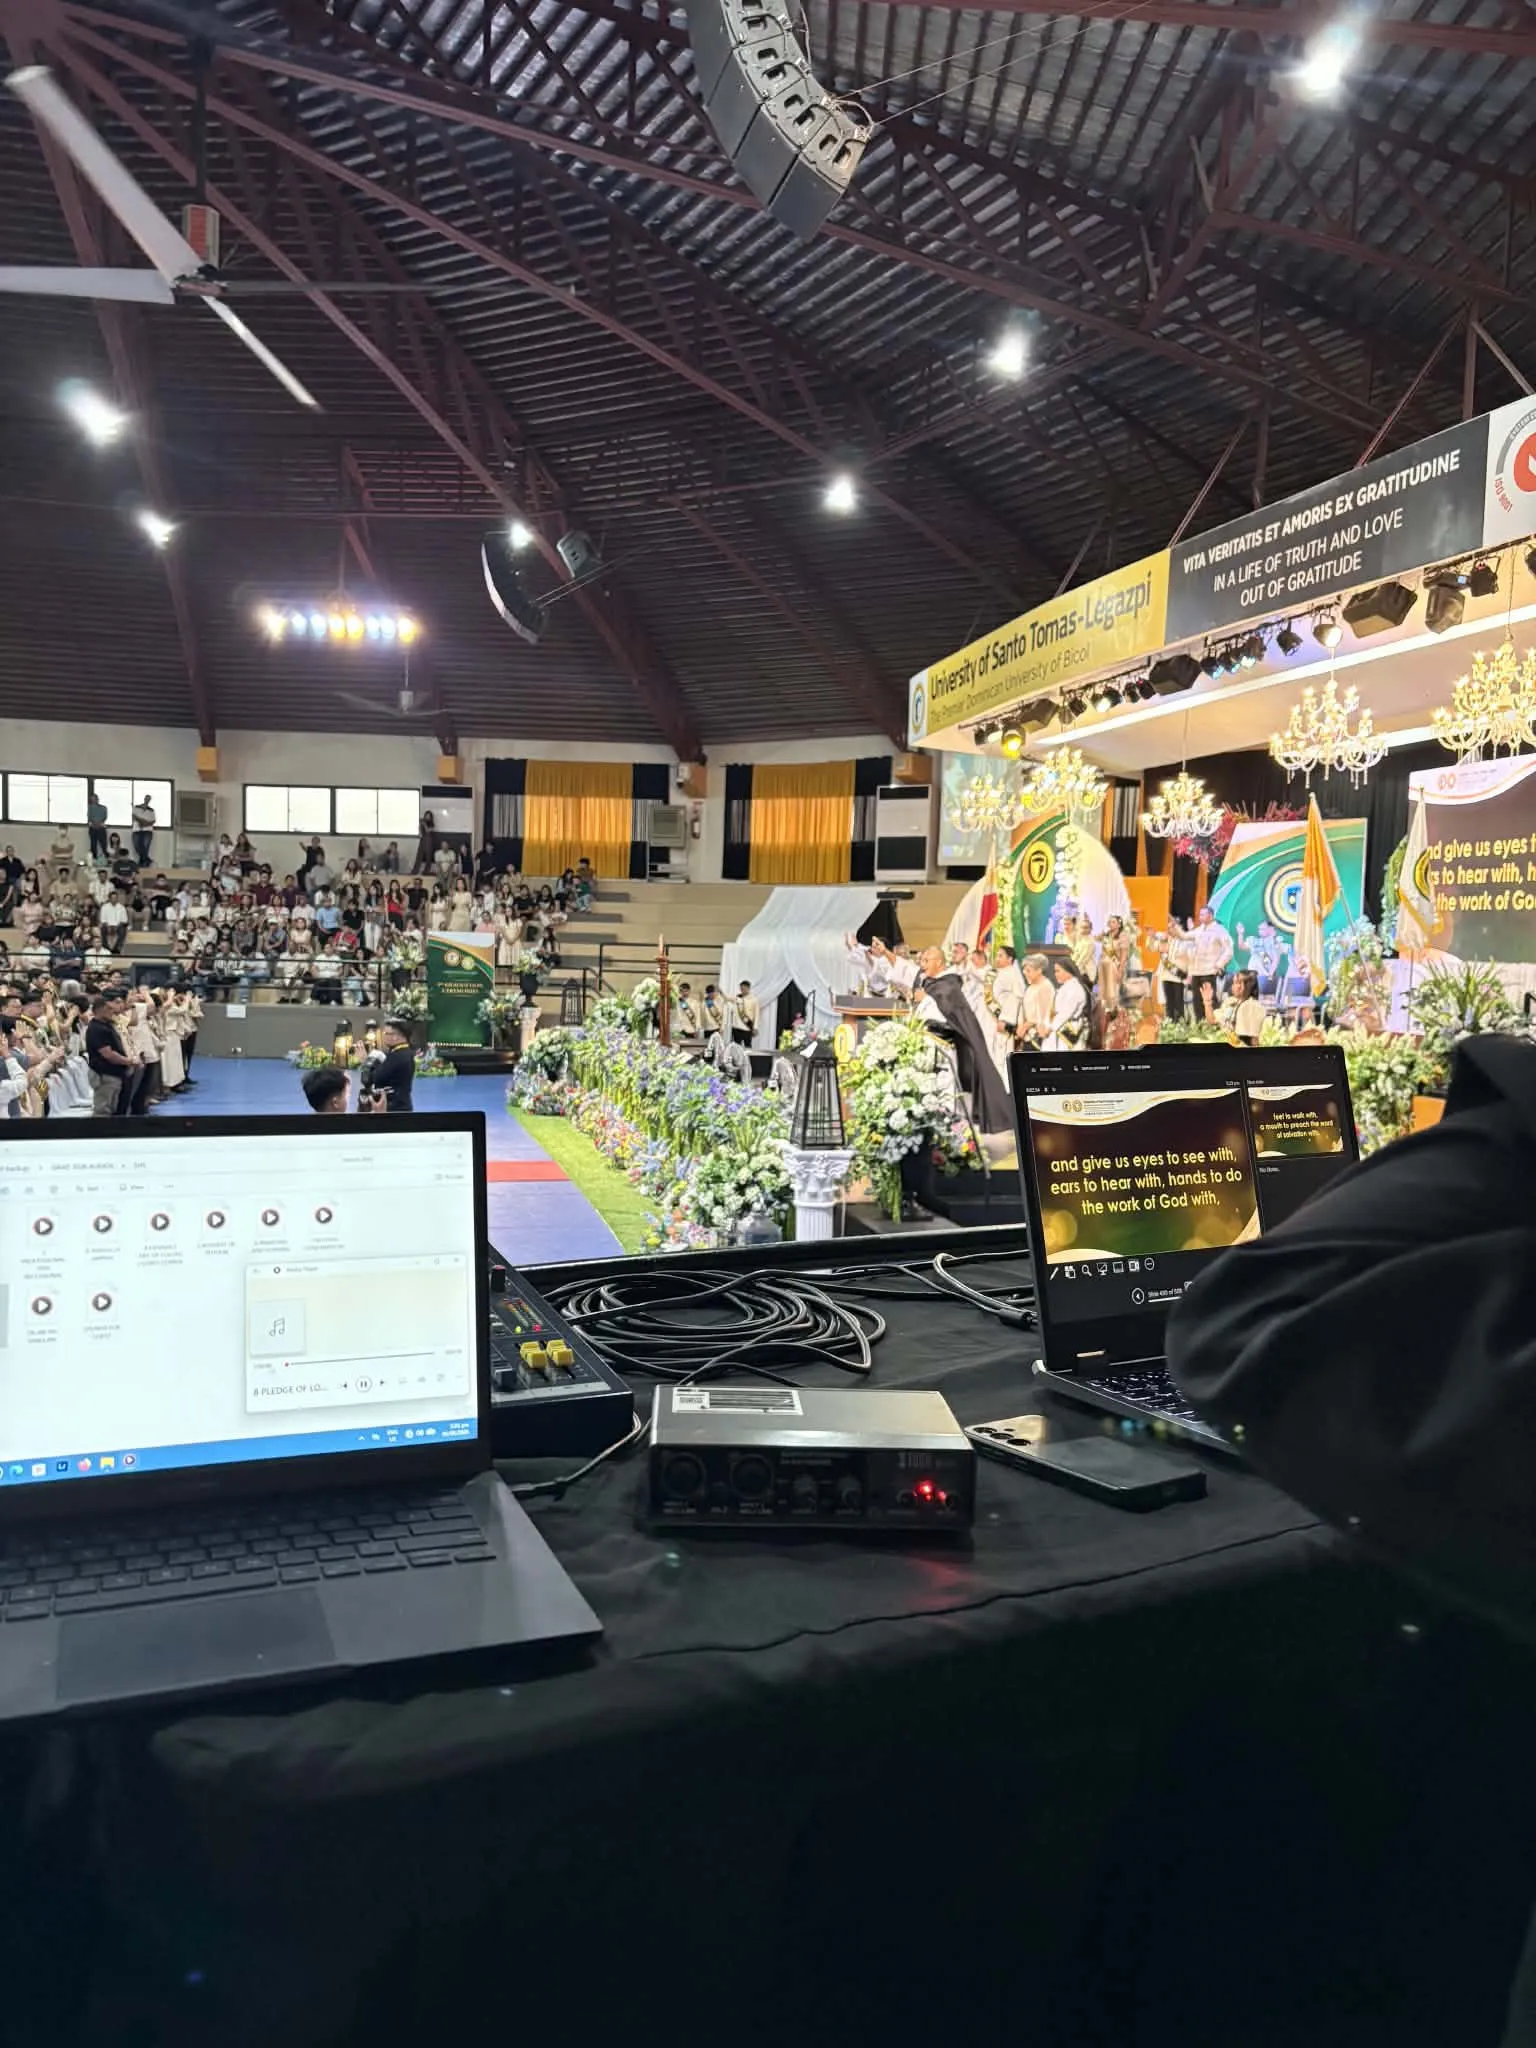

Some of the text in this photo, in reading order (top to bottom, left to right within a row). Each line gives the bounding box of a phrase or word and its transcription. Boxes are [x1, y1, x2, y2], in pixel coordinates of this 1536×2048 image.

[1183, 449, 1461, 574] VITA VERITATIS ET AMORIS EX GRATITUDINE
[1213, 507, 1404, 592] IN A LIFE OF TRUTH AND LOVE
[1240, 550, 1363, 608] OUT OF GRATITUDE
[931, 571, 1152, 700] University of Santo Tomas-Legazpi
[1004, 664, 1048, 700] University
[1050, 656, 1062, 675] of
[1063, 645, 1089, 670] Bicol
[1427, 839, 1442, 860] nd
[1443, 838, 1473, 863] give
[1475, 841, 1491, 857] us
[1493, 837, 1528, 860] eyes
[1442, 866, 1455, 885] to
[1457, 864, 1489, 885] hear
[1490, 862, 1524, 885] with,
[1436, 889, 1536, 912] the work of Go
[1283, 1121, 1289, 1129] to
[1290, 1120, 1310, 1129] preach
[1292, 1111, 1305, 1119] walk
[1050, 1146, 1237, 1174] and give us eyes to see with,
[1050, 1167, 1242, 1195] ears to hear with, hands to do
[1081, 1190, 1220, 1215] the work of God with,
[261, 1385, 294, 1397] PLEDGE
[295, 1384, 307, 1393] OF
